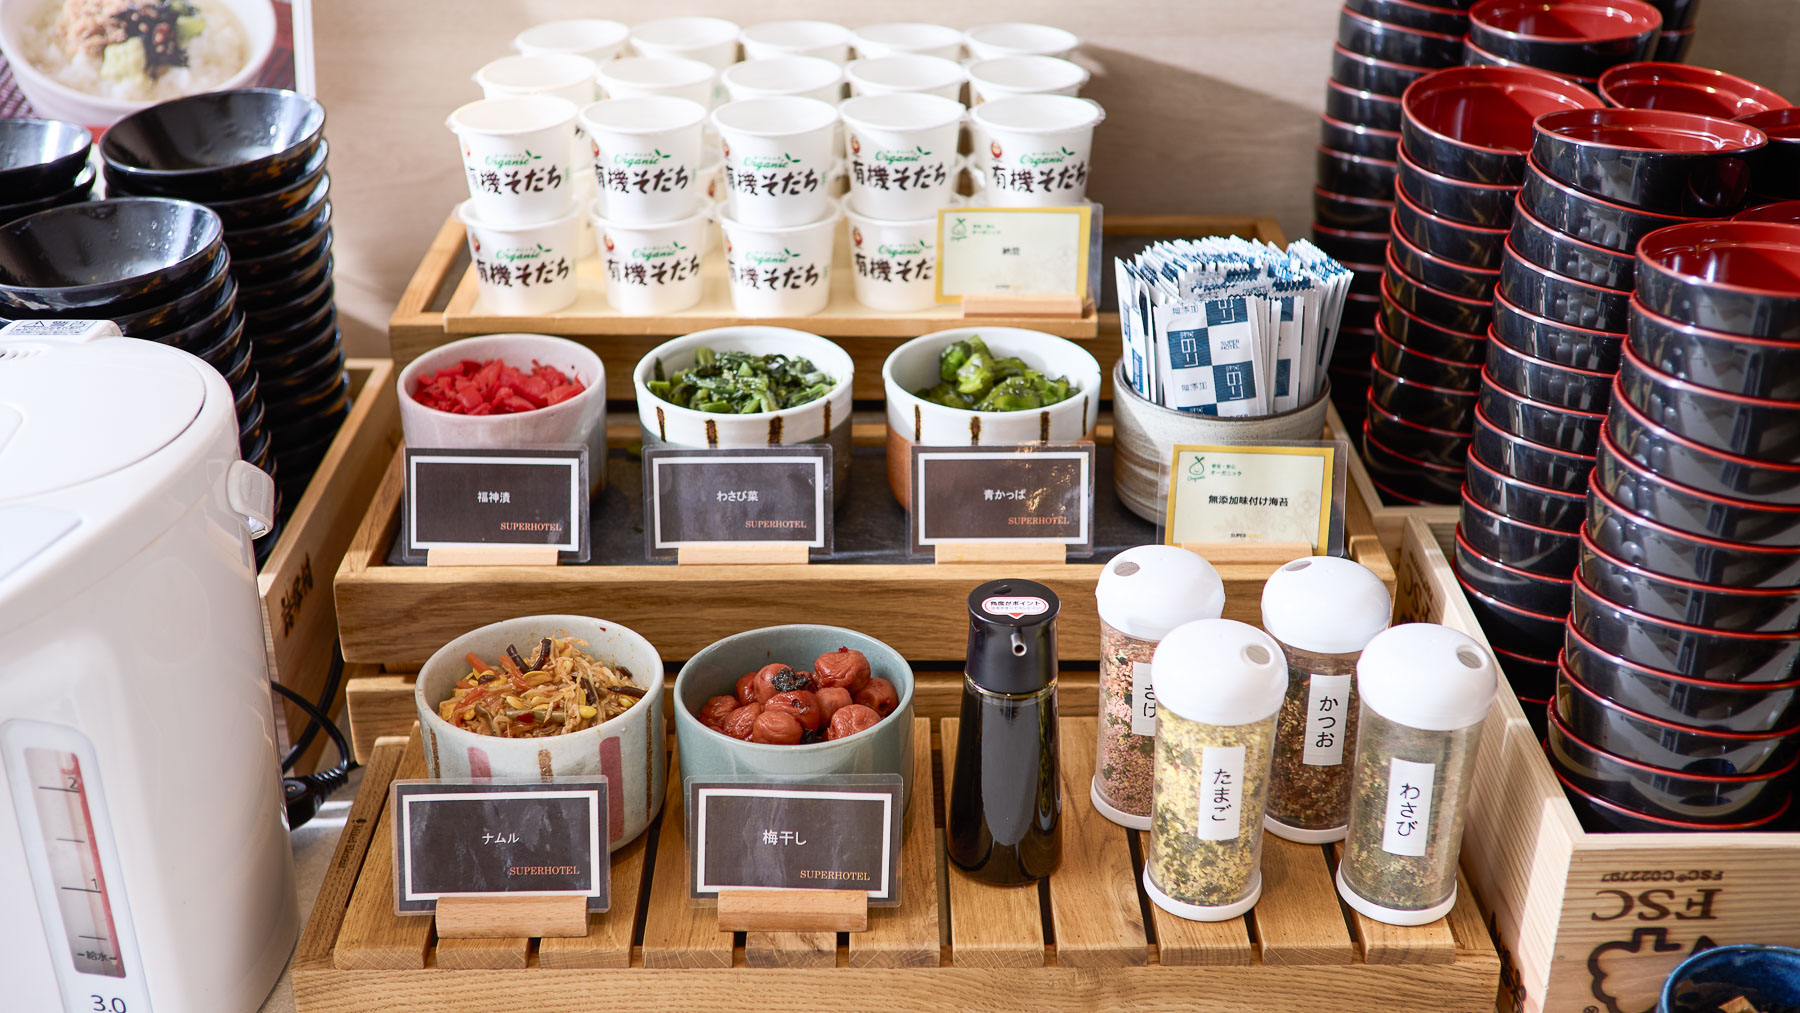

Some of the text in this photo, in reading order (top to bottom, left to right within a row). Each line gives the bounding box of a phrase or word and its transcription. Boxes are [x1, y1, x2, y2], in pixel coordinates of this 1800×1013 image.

[485, 155, 530, 168] Organic
[614, 153, 659, 167] Organic
[744, 156, 788, 170] Organic
[875, 151, 920, 165] Organic
[1020, 154, 1065, 167] Organic
[595, 164, 688, 194] 有機そだち
[726, 165, 818, 197] 有機そだち
[853, 161, 946, 190] 有機そだち
[992, 162, 1086, 193] 有機そだち
[496, 250, 540, 262] Organic
[632, 247, 676, 261] Organic
[746, 252, 788, 265] Organic
[878, 245, 921, 258] Organic
[477, 257, 568, 287] 有機そだち
[605, 254, 699, 286] 有機そだち
[855, 253, 935, 282] 有機そだ
[477, 491, 511, 503] 福神漬
[716, 490, 759, 502] わさび菜
[984, 489, 1026, 501] 青かっぱ
[1208, 494, 1288, 507] 無添加味付け海苔
[500, 522, 562, 531] SUPERHOTEL
[745, 520, 807, 529] SUPERHOTEL
[1008, 516, 1070, 525] SUPERHOTEL
[1315, 695, 1338, 748] かつお
[68, 777, 78, 790] 2
[1211, 768, 1231, 821] たまご
[1396, 783, 1421, 837] わさび
[482, 833, 520, 845] ナムル
[762, 830, 807, 846] 梅干し
[509, 865, 580, 876] SUPERHOTEL
[800, 870, 871, 881] SUPERHOTEL
[1591, 889, 1723, 922] FSC
[91, 995, 126, 1013] 3.0
